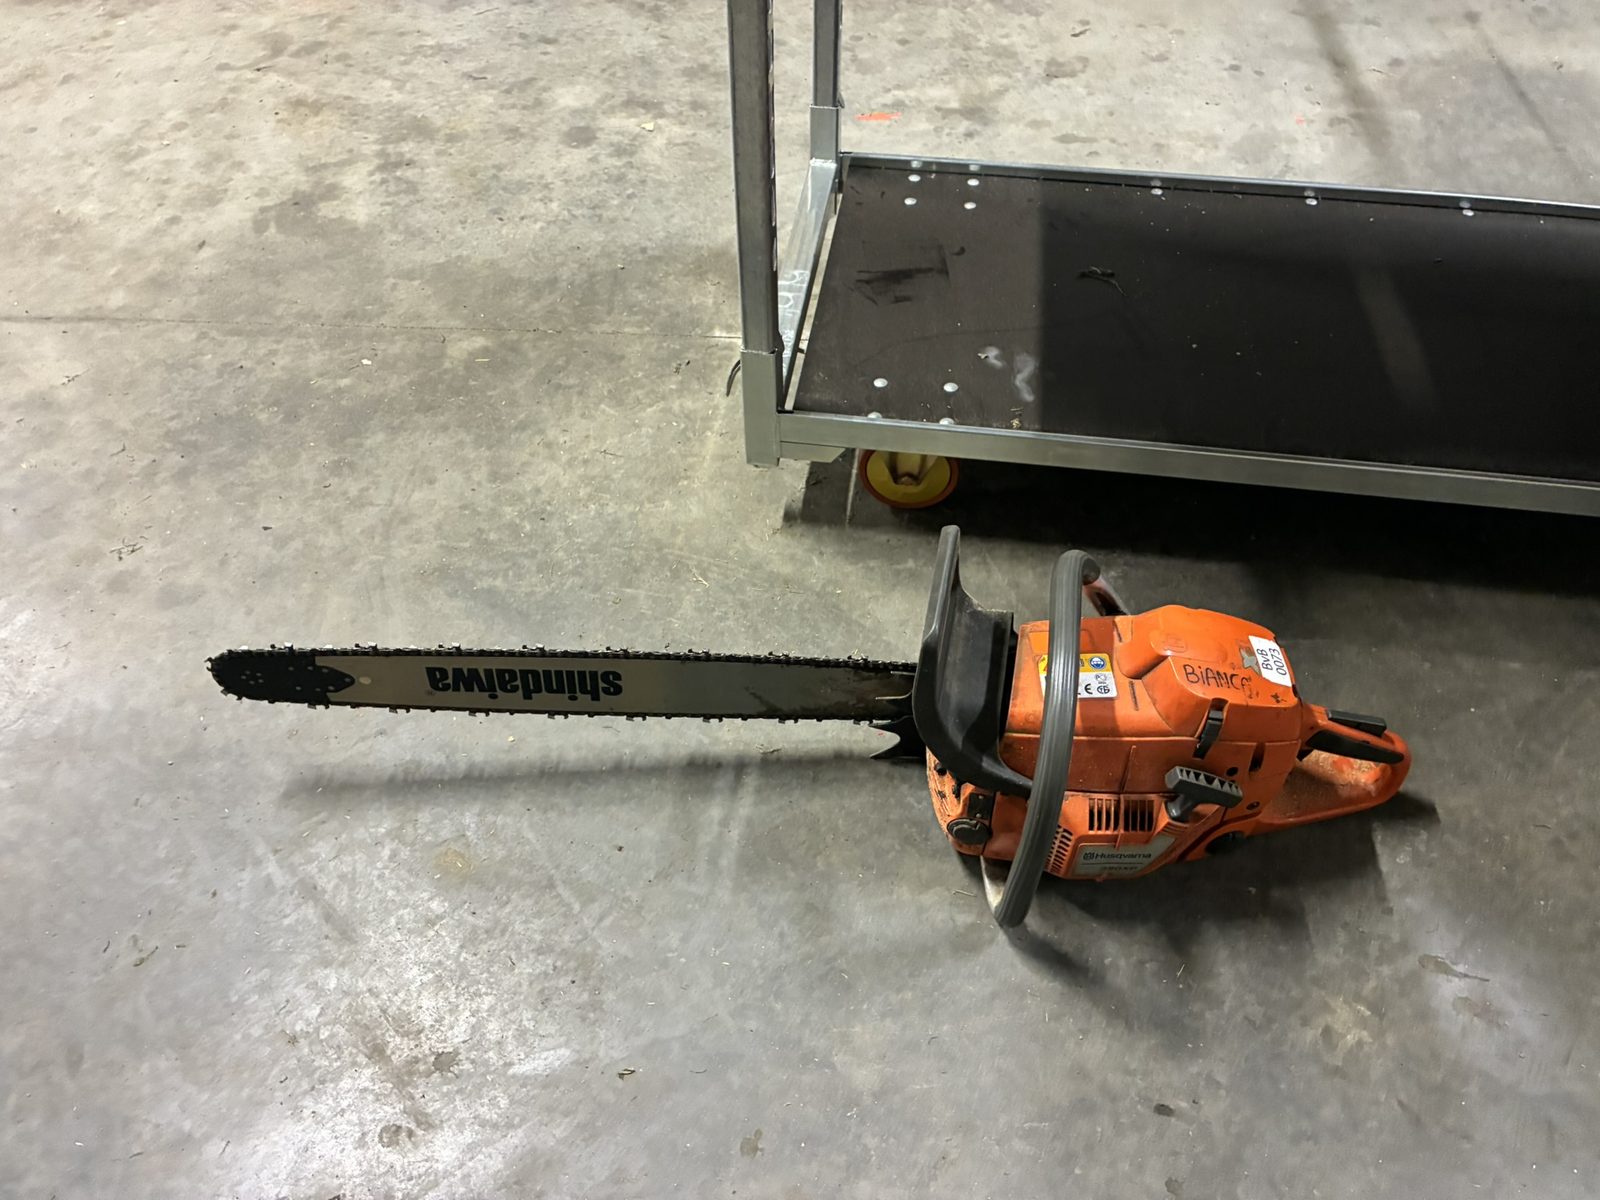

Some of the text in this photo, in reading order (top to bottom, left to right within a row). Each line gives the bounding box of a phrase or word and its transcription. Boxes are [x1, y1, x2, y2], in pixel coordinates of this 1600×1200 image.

[1269, 647, 1287, 676] 0073
[425, 666, 623, 702] shindaiwa
[1095, 852, 1152, 860] Husqvarna
